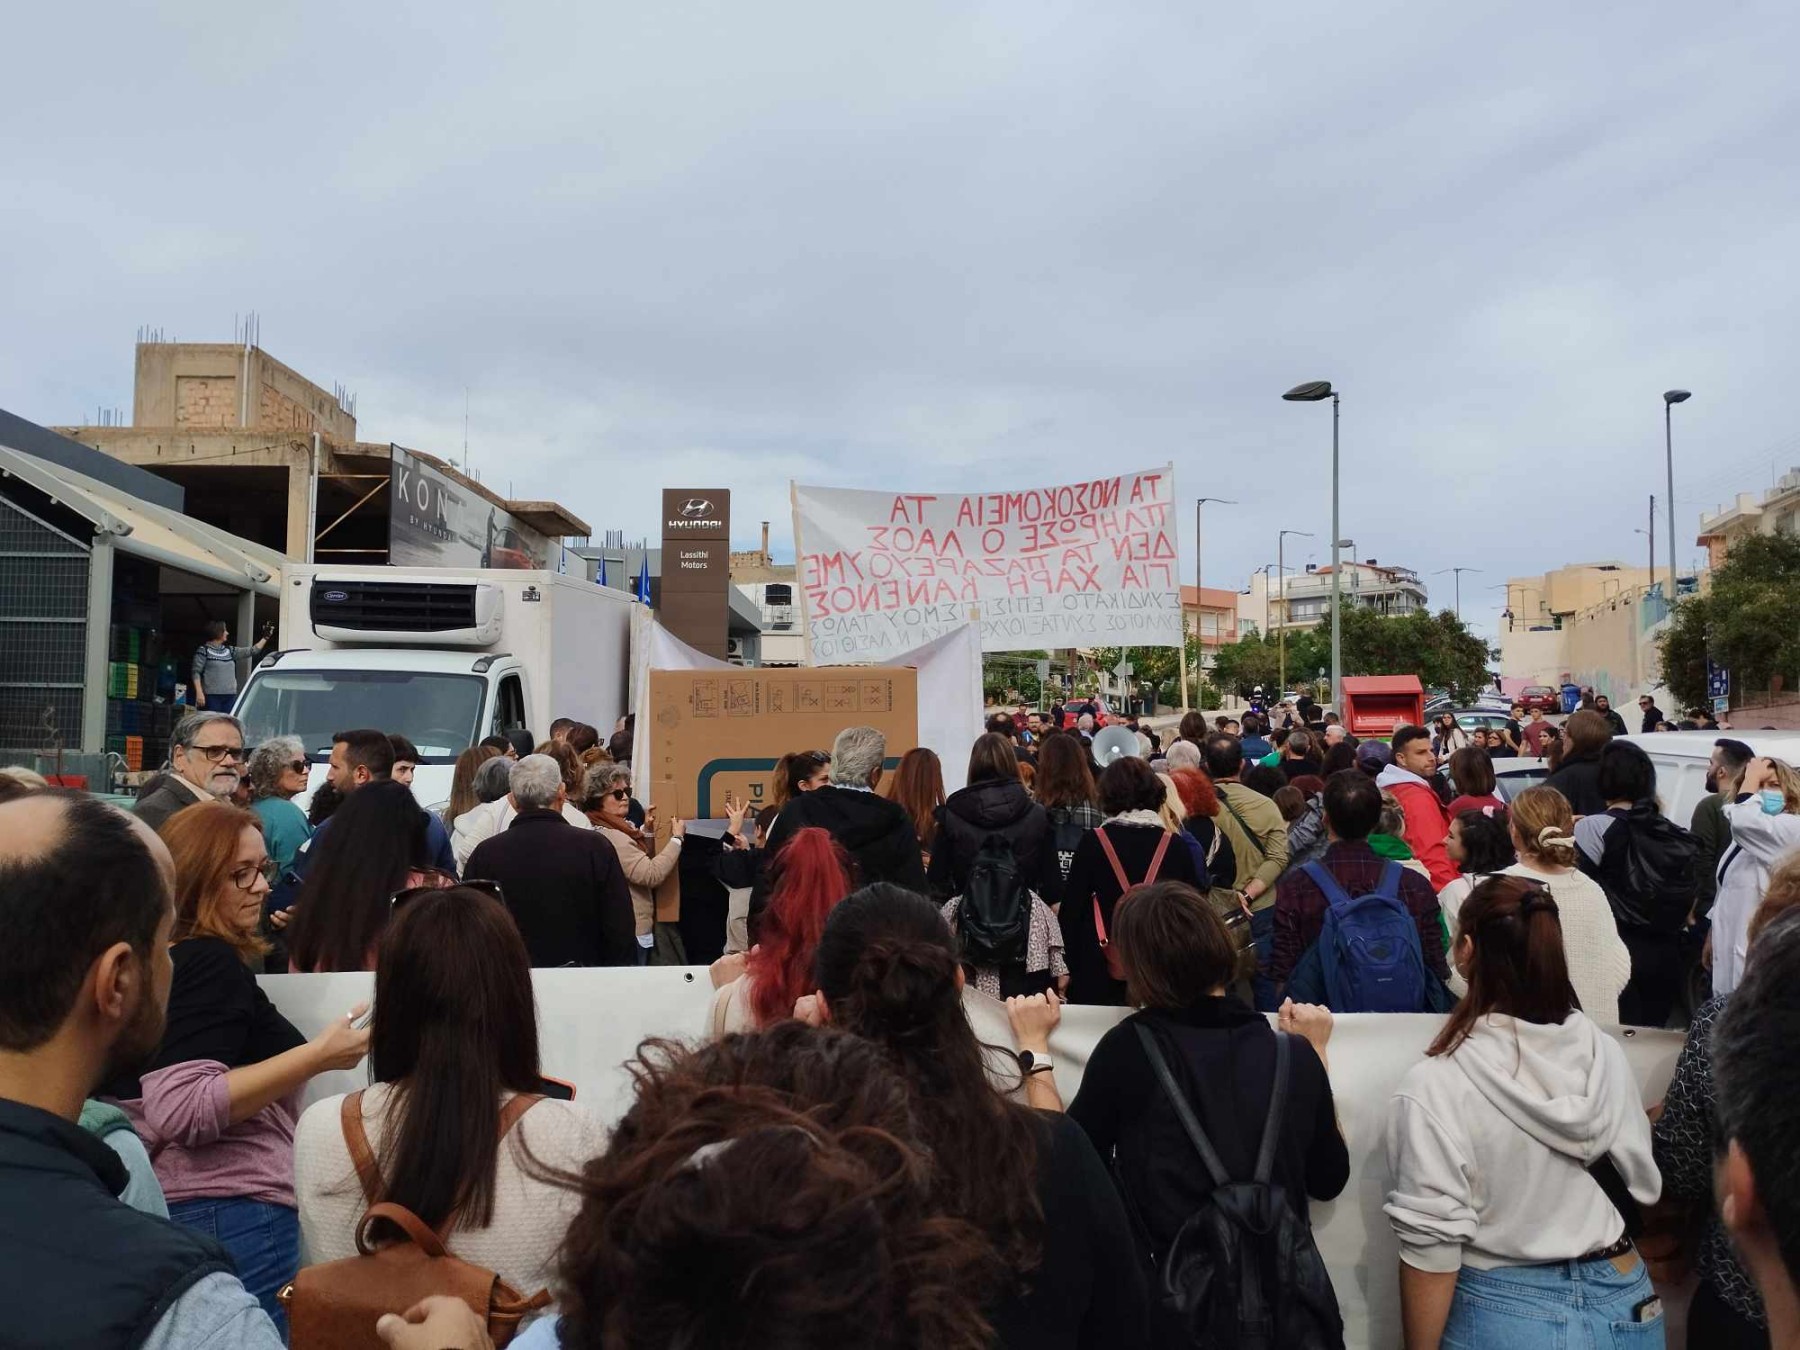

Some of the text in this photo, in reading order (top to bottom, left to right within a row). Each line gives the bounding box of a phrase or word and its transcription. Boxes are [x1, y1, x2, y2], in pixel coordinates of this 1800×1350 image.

[668, 520, 722, 529] HYUNDAI
[680, 550, 709, 559] Lassithi
[681, 561, 708, 569] Motors
